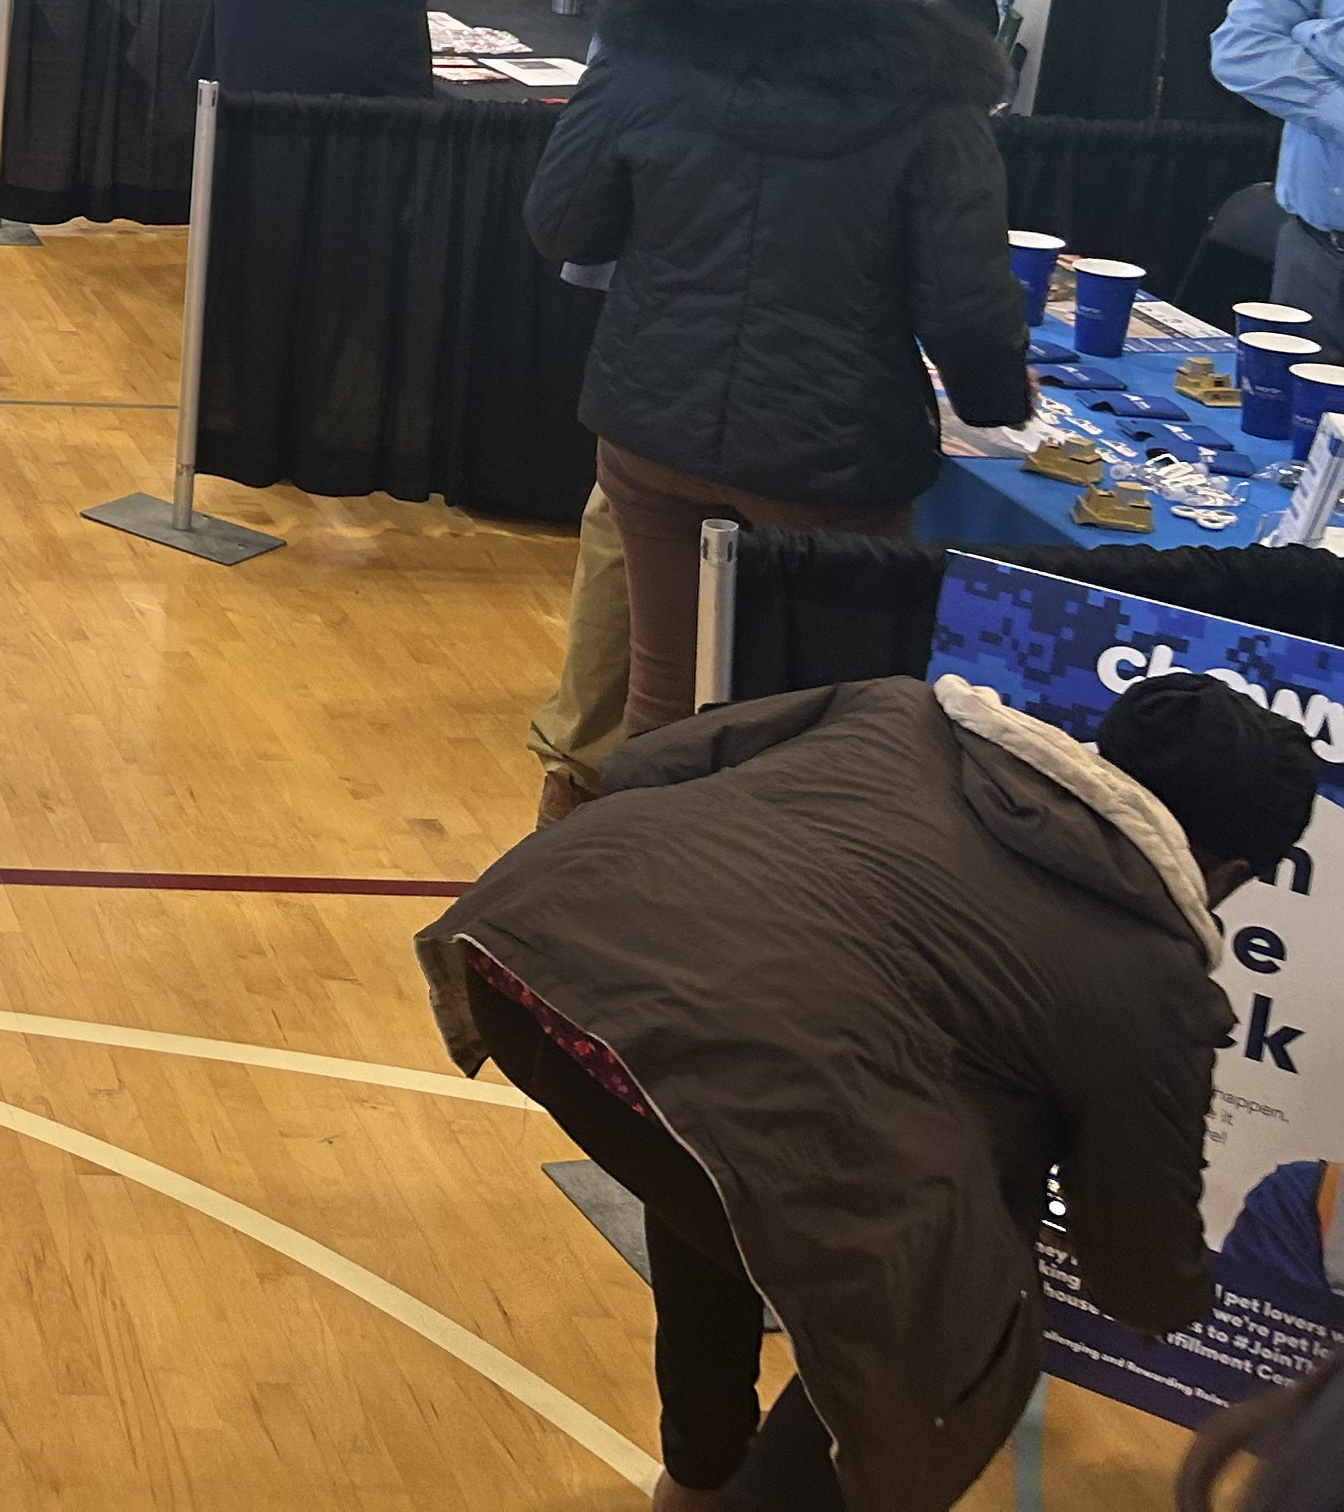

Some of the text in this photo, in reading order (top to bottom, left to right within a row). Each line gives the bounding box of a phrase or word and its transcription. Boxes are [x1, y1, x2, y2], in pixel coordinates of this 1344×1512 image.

[1039, 1258, 1081, 1290] king
[1223, 1291, 1260, 1314] pet
[1263, 1301, 1328, 1337] lovers
[1206, 1324, 1229, 1344] to
[1272, 1330, 1309, 1353] pet
